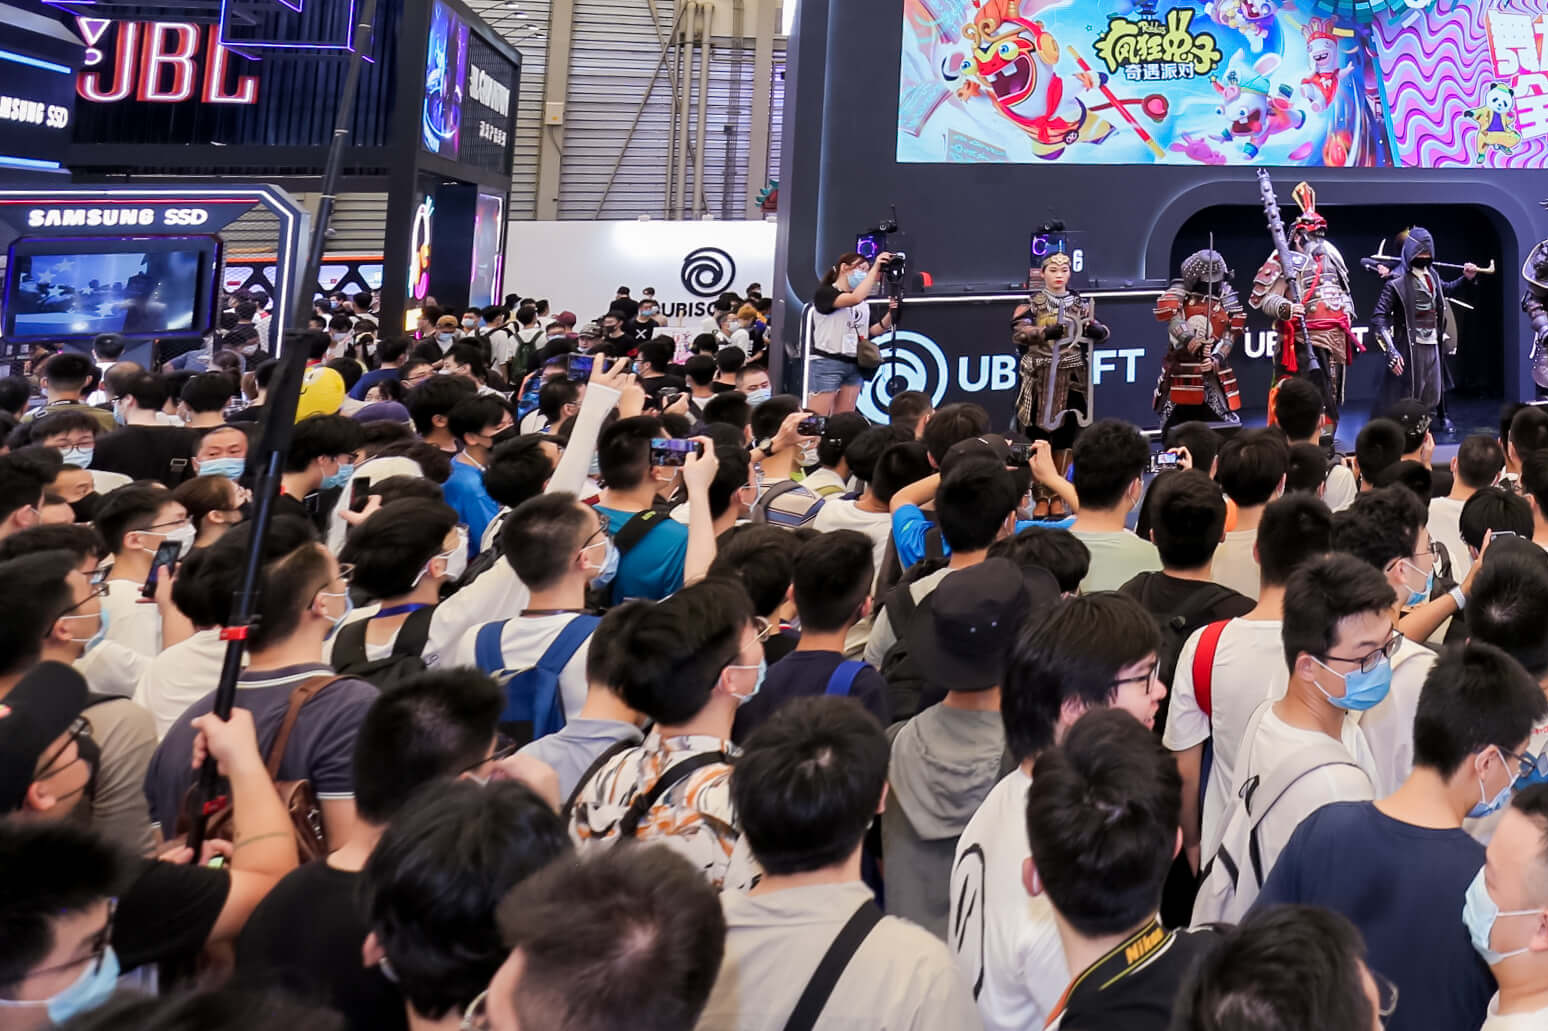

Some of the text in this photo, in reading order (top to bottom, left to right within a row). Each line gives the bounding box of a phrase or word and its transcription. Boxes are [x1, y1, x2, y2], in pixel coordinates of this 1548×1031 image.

[1094, 9, 1222, 74] 疯狂兔子
[75, 20, 260, 104] JBL
[1124, 63, 1195, 81] 奇遇派对
[0, 96, 69, 128] MSUNG SSD
[28, 208, 209, 227] SAMSUNG SSD
[661, 301, 717, 318] UBIS
[958, 348, 1145, 392] UBFT
